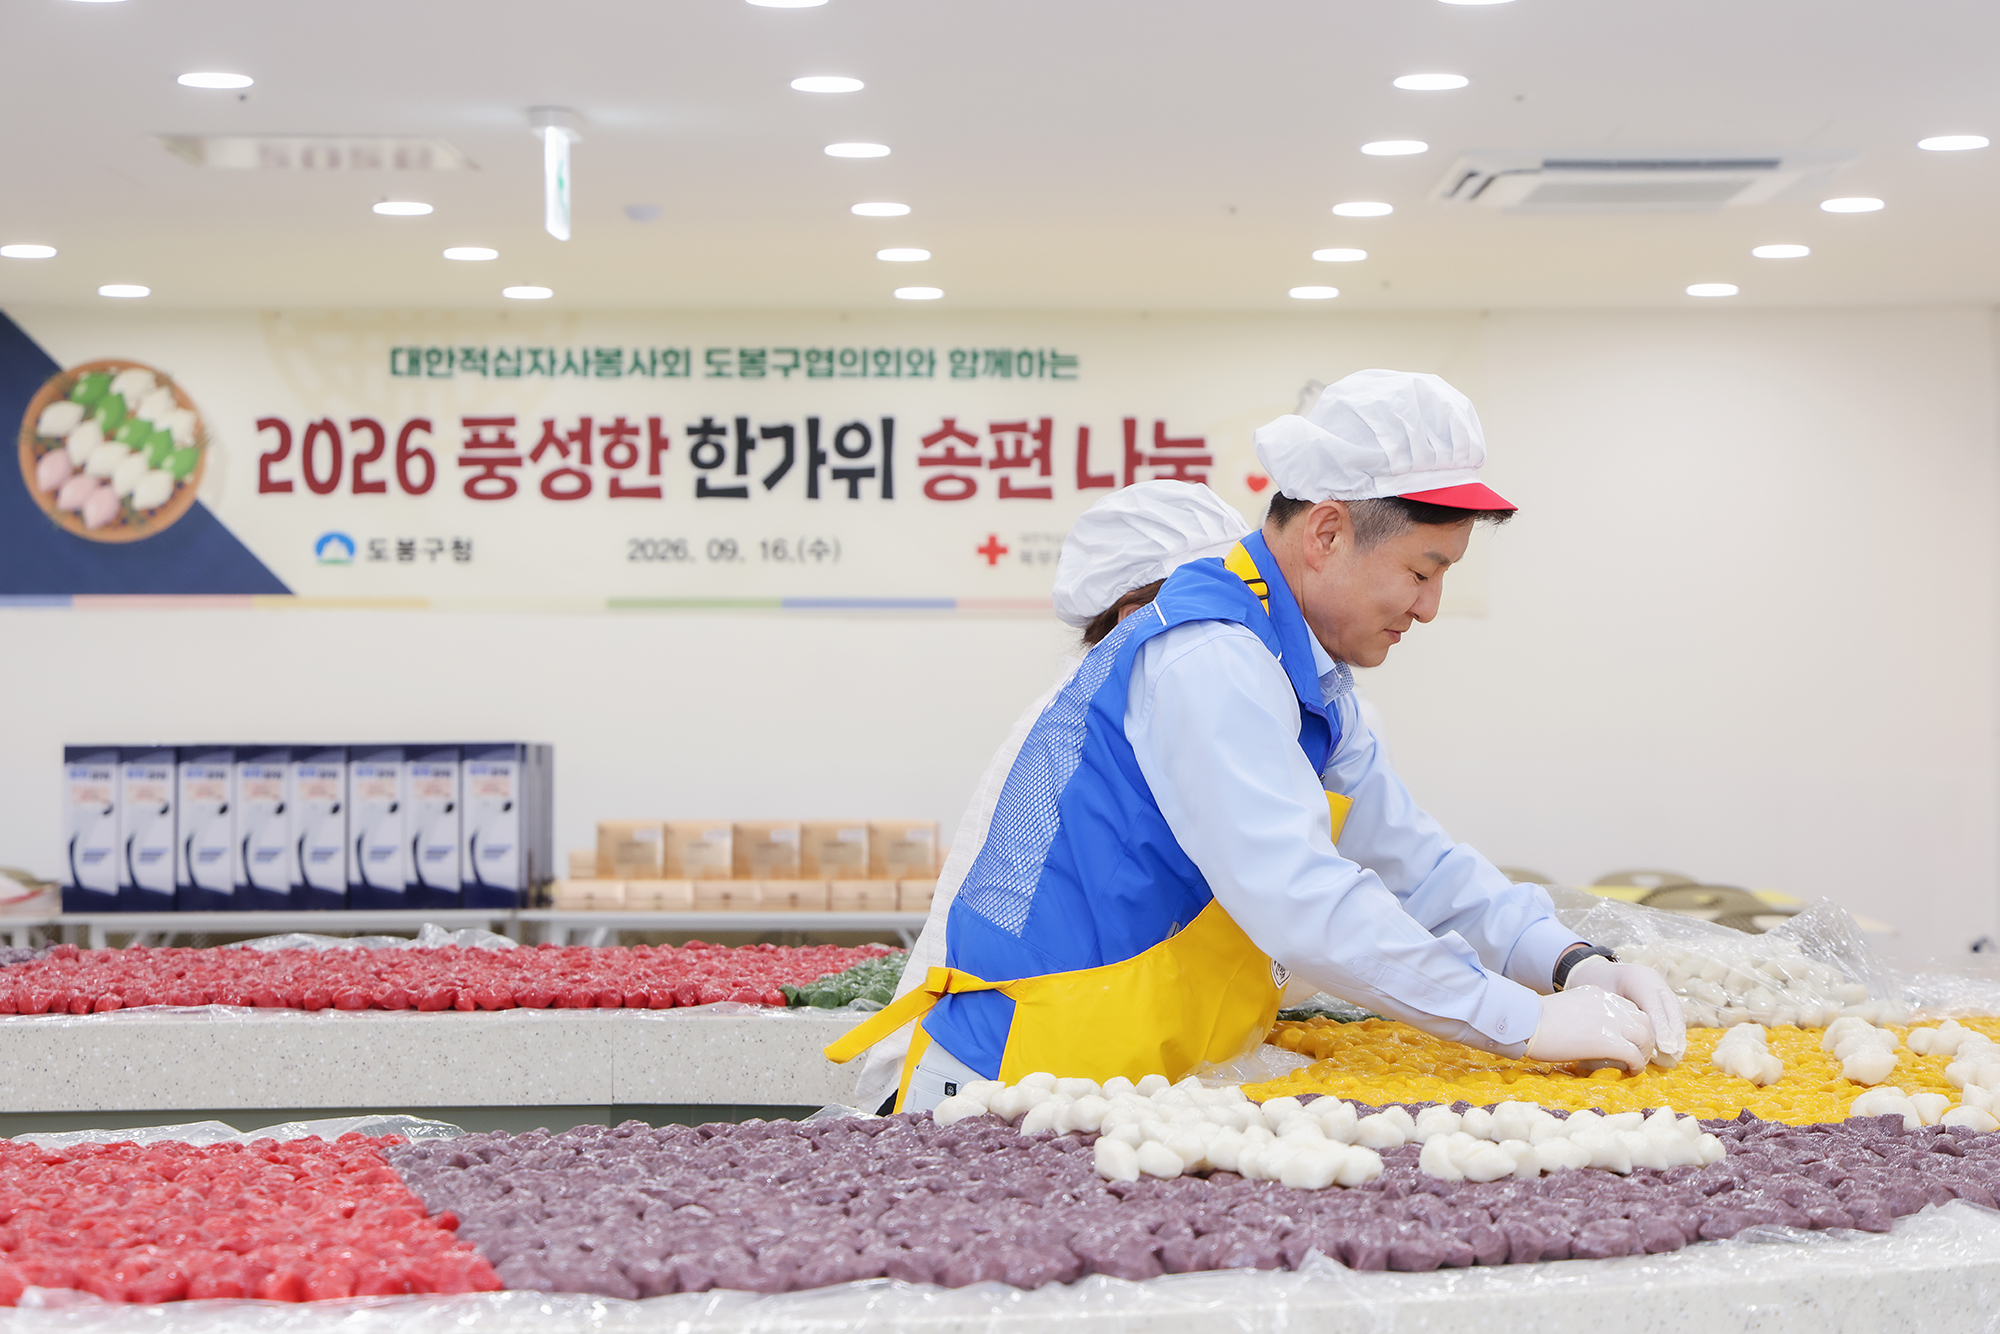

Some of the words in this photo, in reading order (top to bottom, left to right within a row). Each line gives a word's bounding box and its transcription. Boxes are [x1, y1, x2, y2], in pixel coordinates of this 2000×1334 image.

[704, 347, 937, 379] 도봉구협의회와
[947, 348, 1079, 380] 함께하는
[256, 416, 437, 497] 2026
[457, 415, 671, 502] 풍성한
[685, 415, 896, 501] 한가위
[917, 416, 1054, 502] 송편
[1075, 416, 1214, 490] 나눔
[367, 537, 473, 563] 도봉구청
